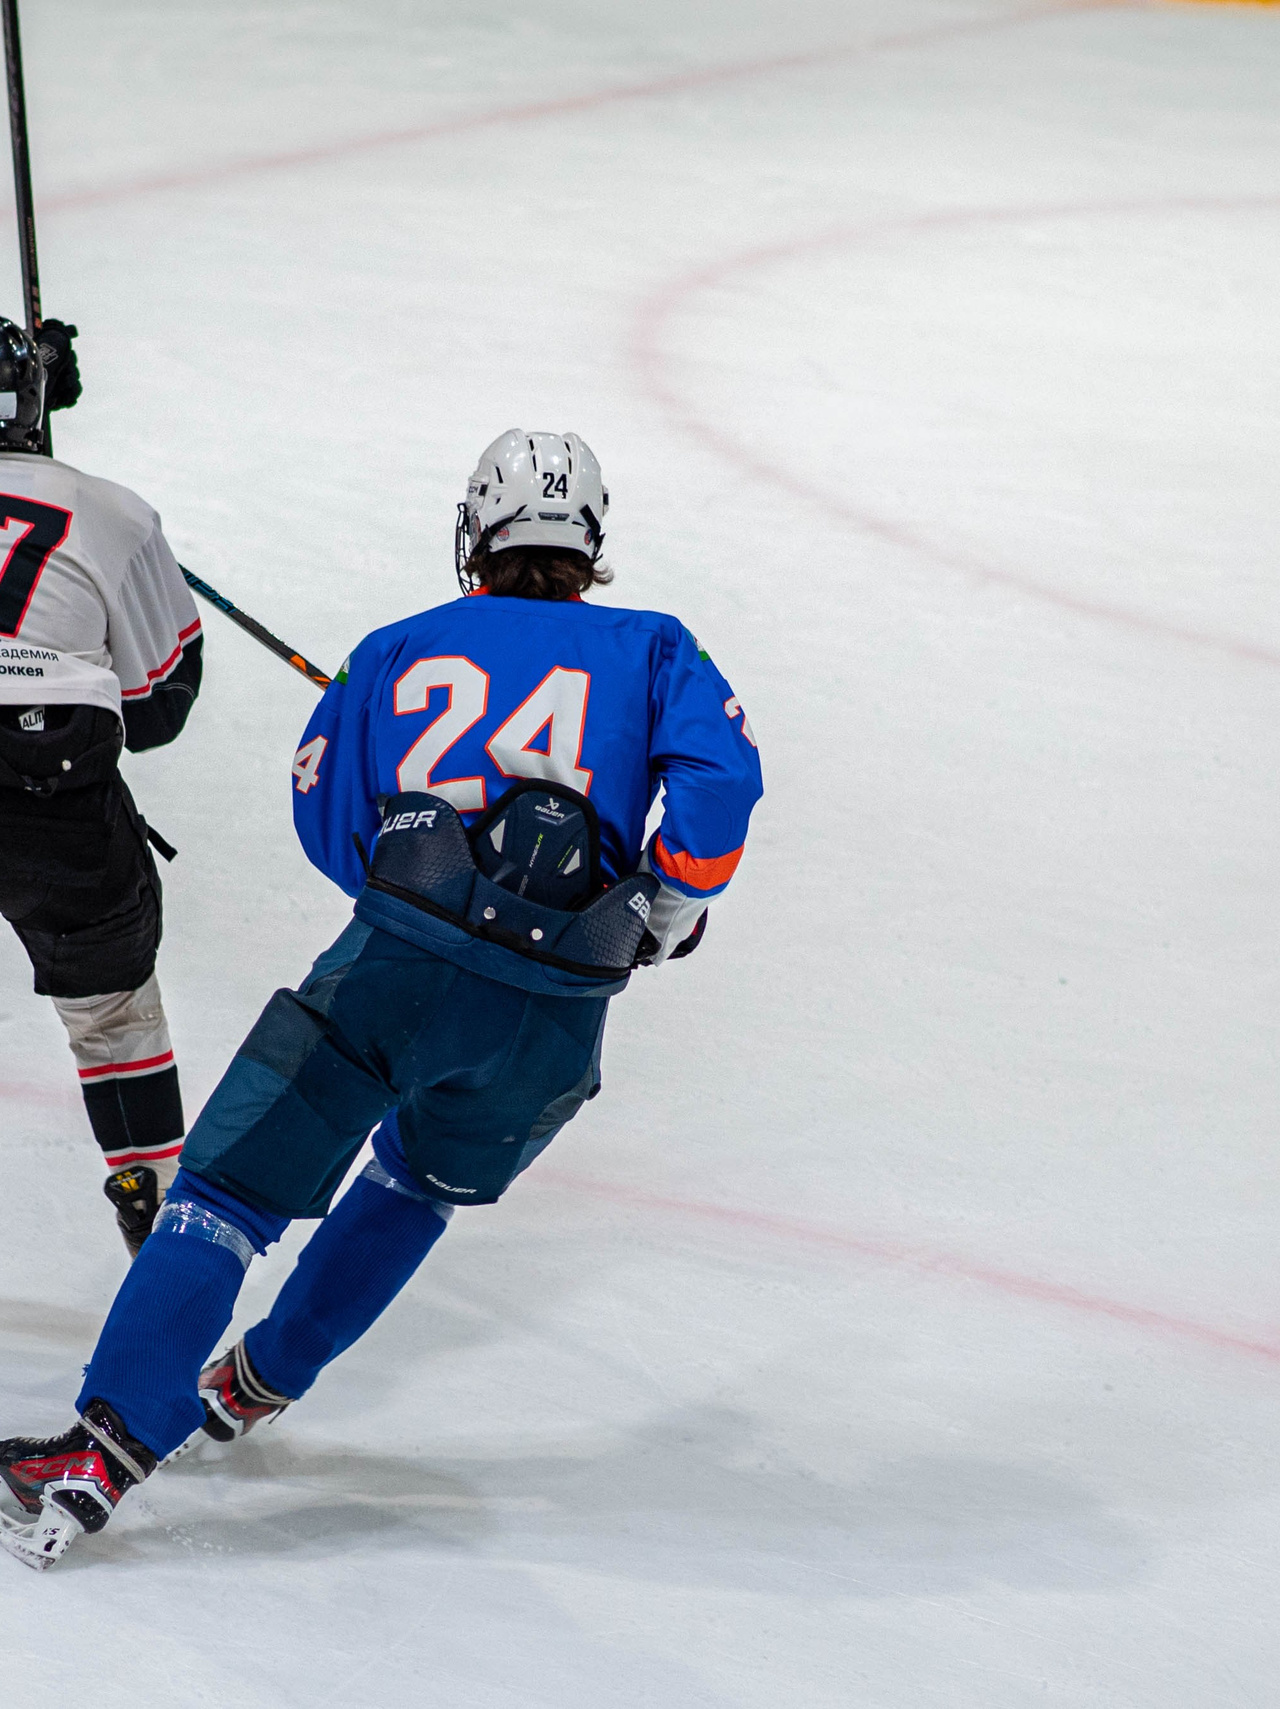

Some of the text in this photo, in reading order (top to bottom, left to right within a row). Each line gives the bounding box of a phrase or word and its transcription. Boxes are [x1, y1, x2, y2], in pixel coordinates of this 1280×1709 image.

[542, 471, 569, 500] 24
[393, 655, 593, 814] 24
[292, 734, 328, 795] 4
[378, 810, 437, 838] UER
[534, 804, 565, 819] BAUER
[627, 891, 652, 924] BA
[426, 1174, 477, 1194] BAUER
[19, 1456, 97, 1478] CCM
